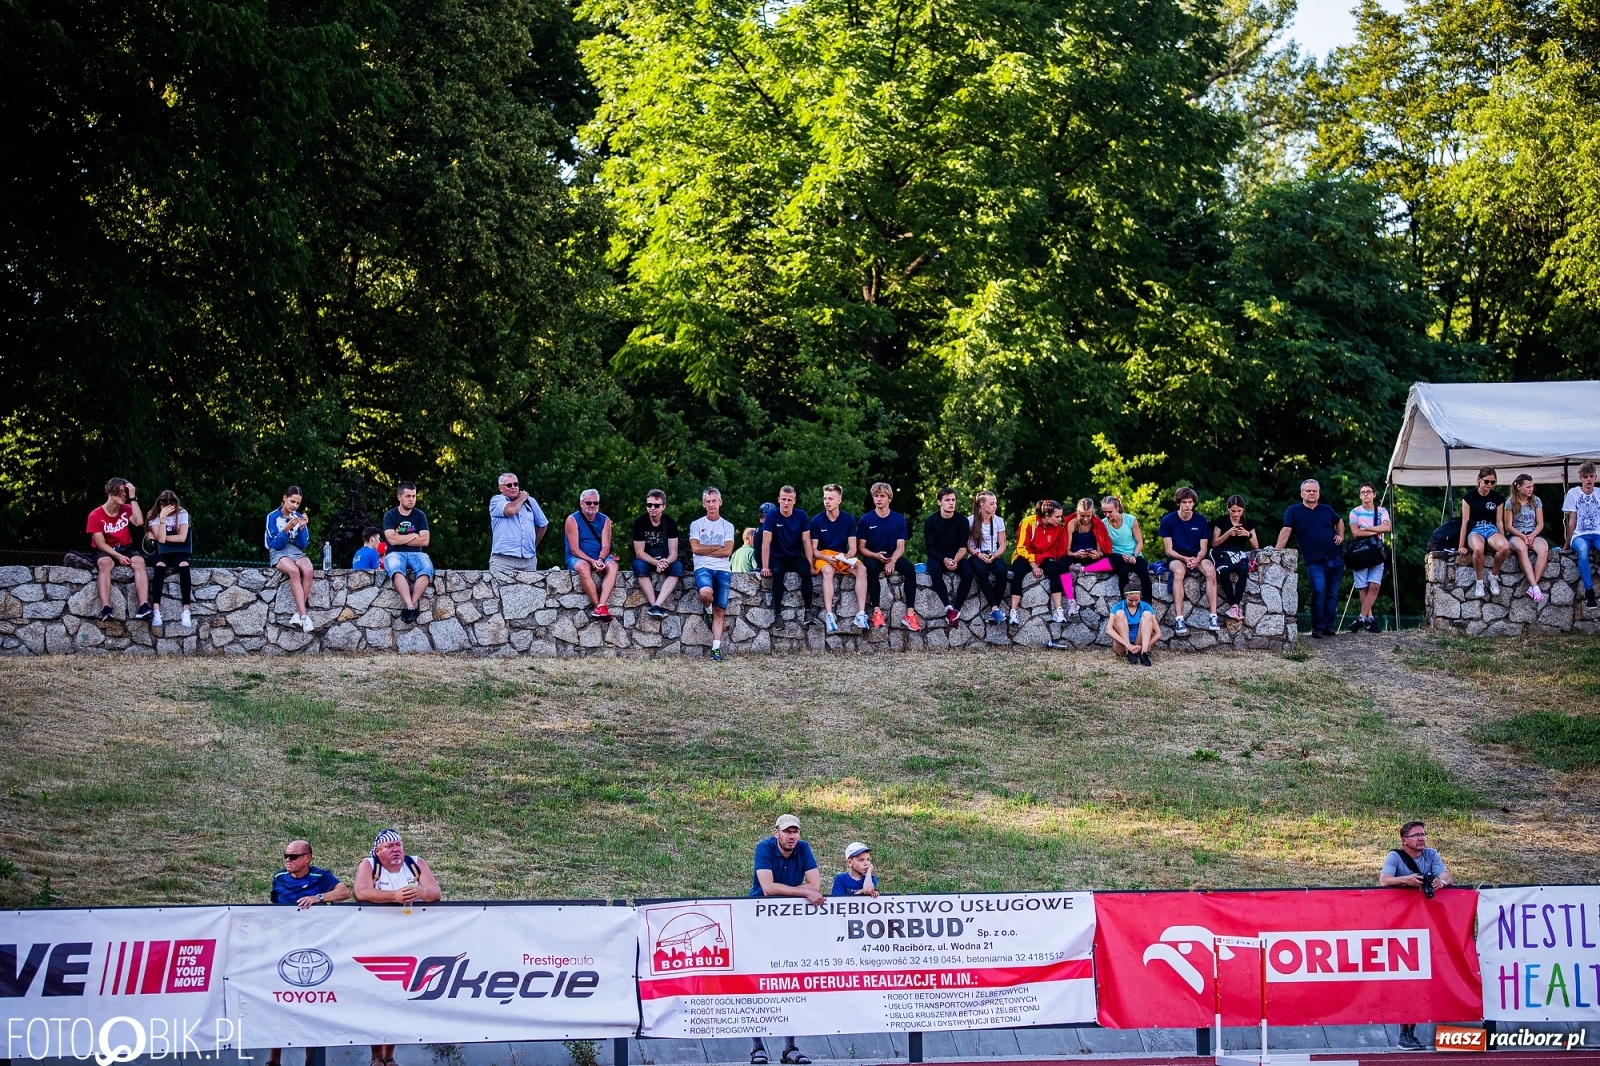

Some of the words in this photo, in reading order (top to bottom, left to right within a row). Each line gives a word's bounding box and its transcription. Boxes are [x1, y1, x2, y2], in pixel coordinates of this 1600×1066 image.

[755, 900, 954, 918] PRZEDSIĘBIORSTWO
[960, 897, 1074, 912] USŁUGOWE
[977, 928, 992, 938] Sp.
[1001, 929, 1018, 937] o.o.
[1498, 902, 1600, 950] NESTL
[179, 945, 204, 956] NOW
[861, 944, 890, 953] 47-400
[892, 943, 935, 953] Racibórz,
[937, 942, 948, 951] ul.
[950, 941, 981, 951] Wodna
[983, 941, 994, 950] 21
[177, 956, 197, 966] IT'S
[522, 953, 595, 968] Prestigeauto
[770, 959, 799, 969] tel./fax
[800, 958, 812, 968] 32
[813, 958, 830, 967] 415
[832, 958, 843, 967] 39
[845, 957, 858, 968] 45,
[859, 956, 908, 967] księgowość
[909, 957, 921, 965] 32
[922, 956, 938, 965] 419
[940, 955, 965, 965] 0454,
[966, 953, 1014, 963] betoniarnia
[1015, 953, 1026, 962] 32
[1027, 951, 1065, 962] 4181512
[1268, 936, 1420, 975] ORLEN
[661, 956, 724, 970] BORBUD
[176, 966, 205, 977] YOUR
[174, 976, 205, 988] MOVE
[759, 977, 800, 991] FIRMA
[803, 975, 860, 990] OFERUJE
[863, 972, 937, 989] REALIZACJĘ
[940, 971, 979, 986] M.IN.:
[272, 990, 337, 1004] TOYOTA
[887, 992, 913, 1001] ROBÓT
[914, 991, 970, 1001] BETONOWYCH
[975, 986, 1029, 998] ŻELBETOWYCH
[690, 997, 714, 1006] ROBÓT
[714, 996, 807, 1006] OGÓLNOBUDOWLANYCH
[888, 1002, 914, 1010] USŁUG
[915, 995, 1038, 1009] TRANSPORTOWO-SPRZĘTOWYCH
[690, 1007, 714, 1016] ROBÓT
[715, 1006, 782, 1015] INSTALACYJNYCH
[889, 1011, 914, 1019] USŁUG
[915, 1010, 957, 1019] KRUSZENIA
[958, 1008, 989, 1018] BETONU
[995, 1004, 1040, 1015] ŻELBETONU
[690, 1017, 739, 1025] KONSTRUKCJI
[740, 1015, 789, 1025] STALOWYCH
[890, 1020, 932, 1029] PRODUKCJI
[937, 1018, 989, 1027] DYSTRYBUCJI
[990, 1015, 1021, 1024] BETONU
[689, 1026, 714, 1035] ROBÓT
[715, 1025, 767, 1034] DROGOWYCH
